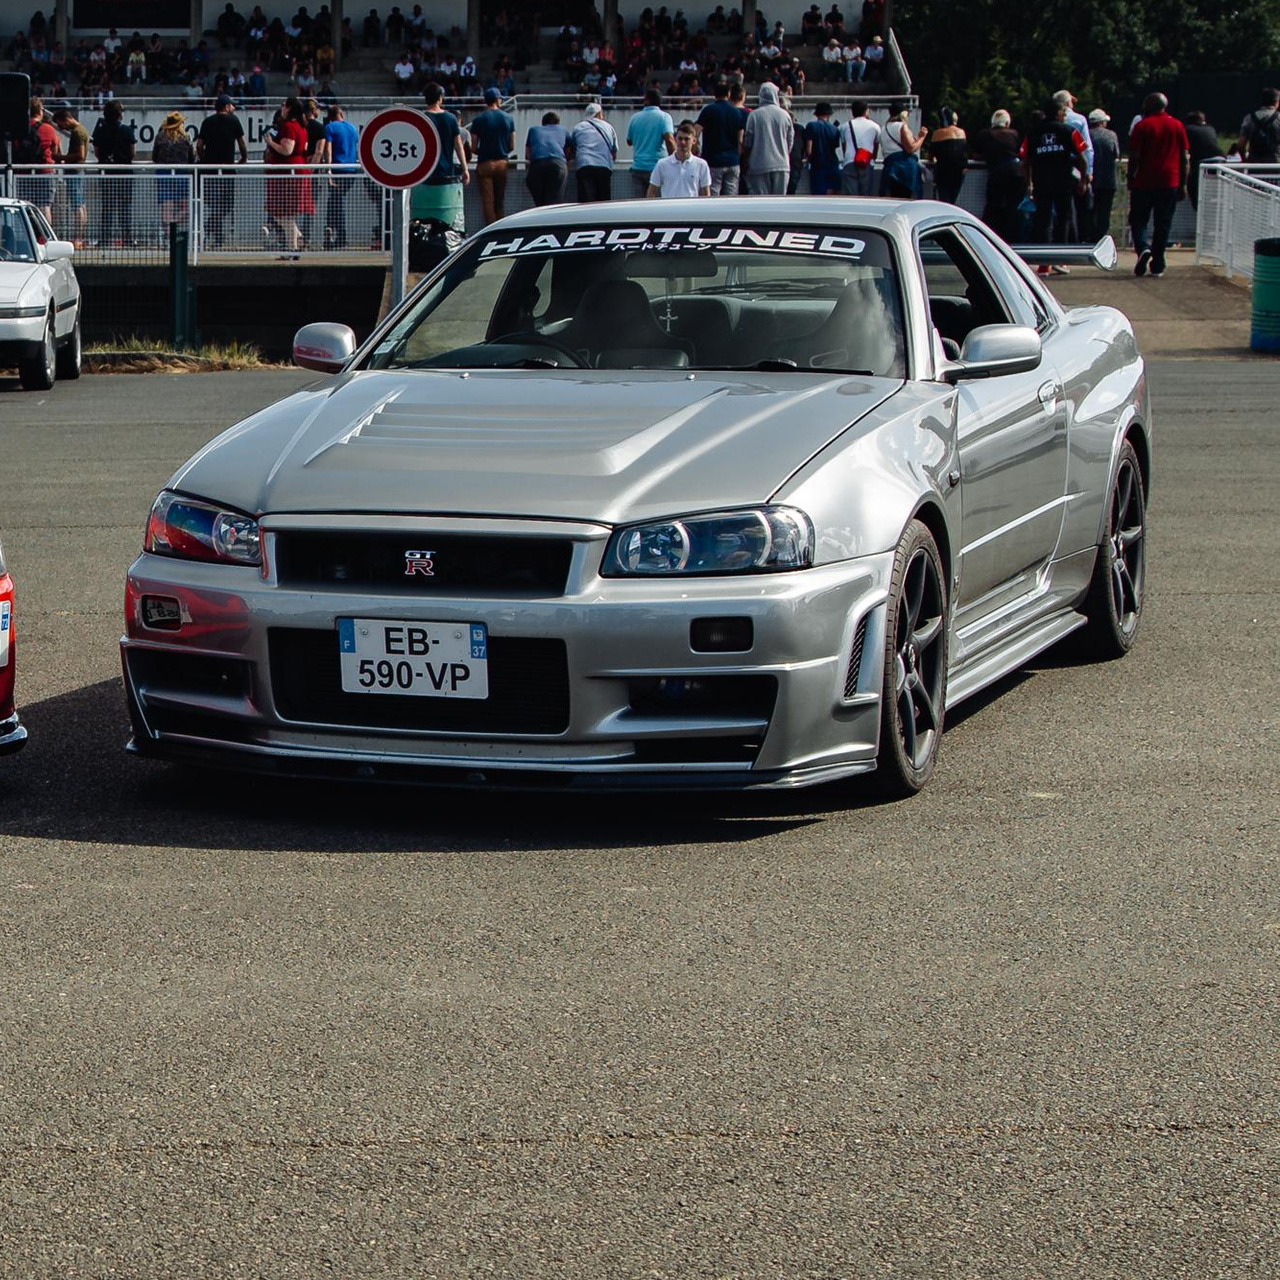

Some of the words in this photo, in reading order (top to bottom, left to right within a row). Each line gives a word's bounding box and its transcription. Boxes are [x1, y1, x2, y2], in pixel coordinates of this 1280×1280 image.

[380, 139, 418, 161] 3,5t
[1036, 144, 1065, 154] HONDA
[481, 227, 866, 256] HARDTUNED
[404, 550, 437, 559] GT
[404, 558, 435, 576] R
[344, 640, 351, 649] F
[472, 646, 486, 657] 37
[358, 659, 470, 691] 590-VP
